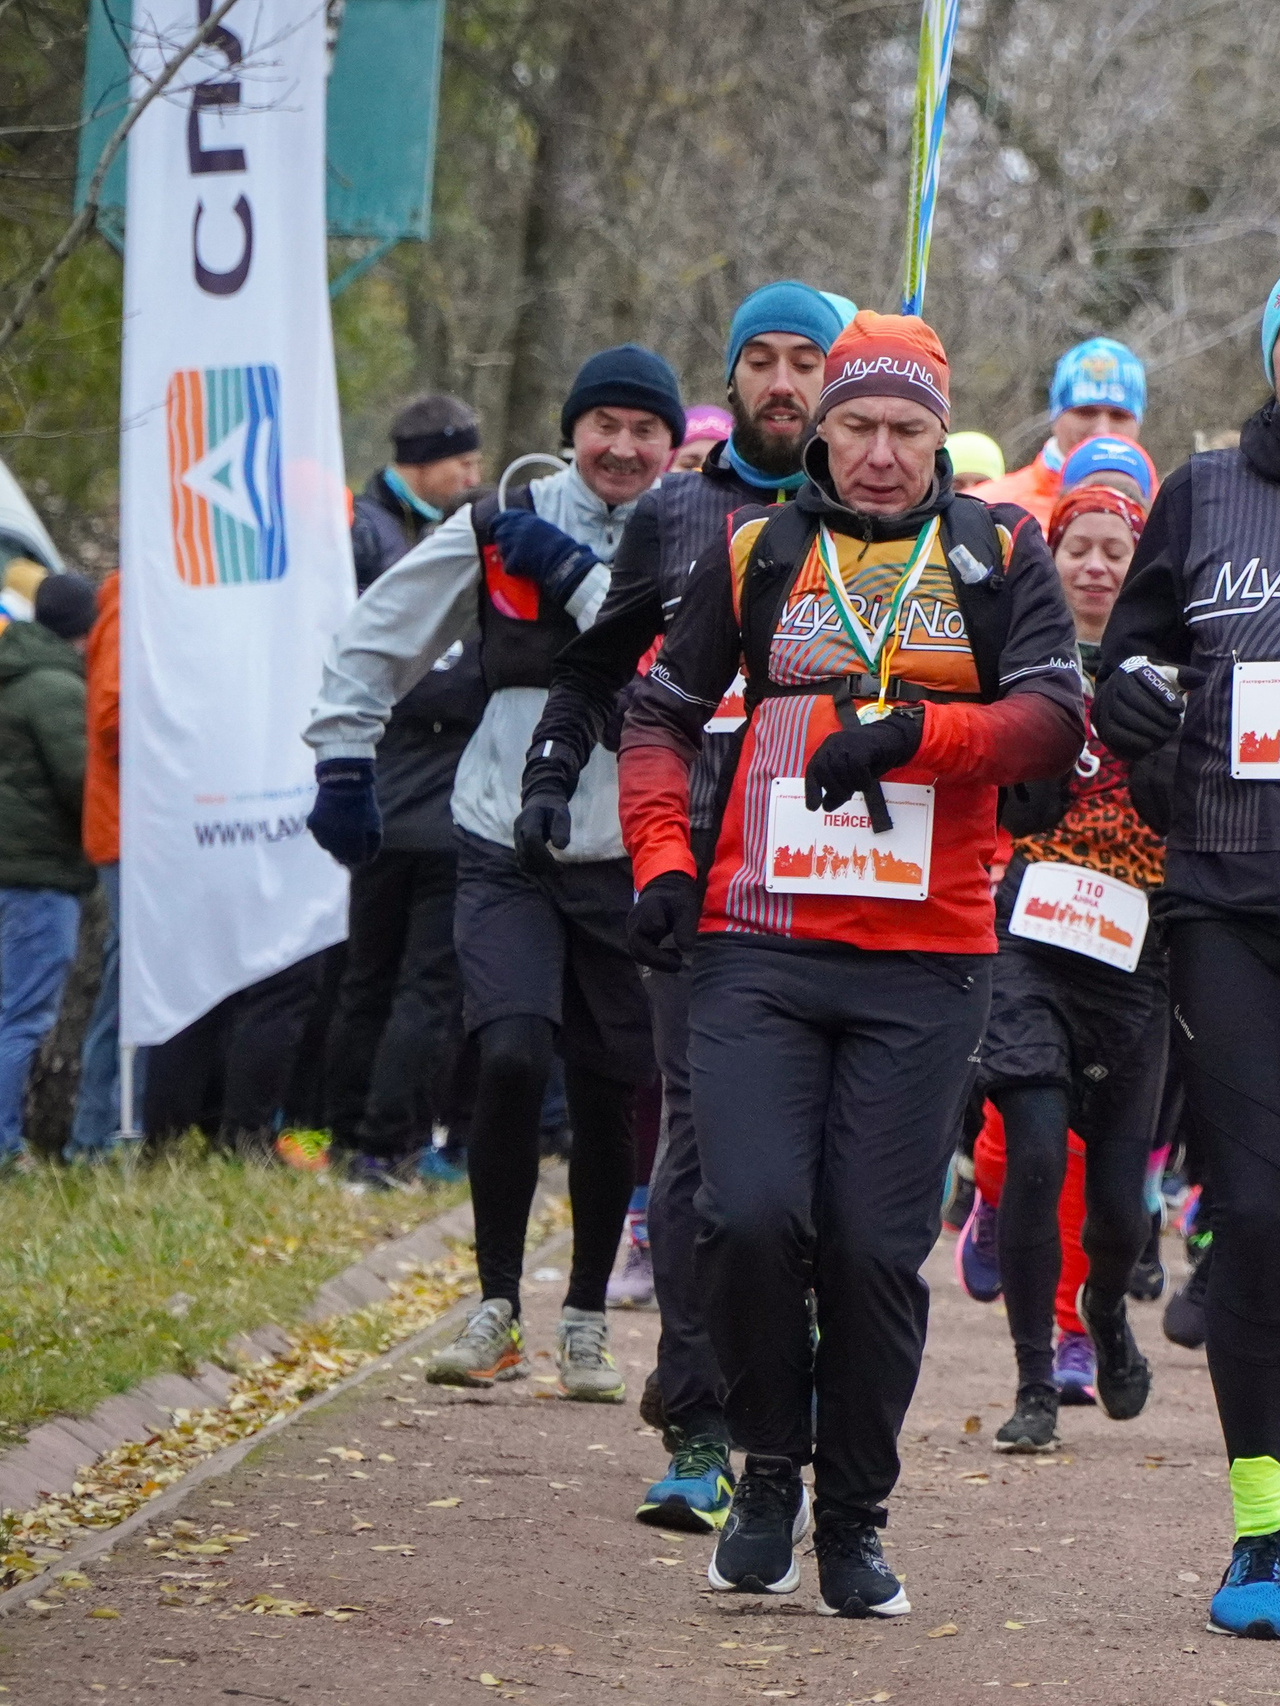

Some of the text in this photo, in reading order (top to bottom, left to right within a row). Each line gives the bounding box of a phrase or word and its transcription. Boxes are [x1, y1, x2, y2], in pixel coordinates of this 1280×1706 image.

[840, 356, 936, 387] MyRUNo
[1072, 382, 1125, 402] RUS
[1142, 667, 1177, 703] loopline
[1075, 879, 1104, 899] 110
